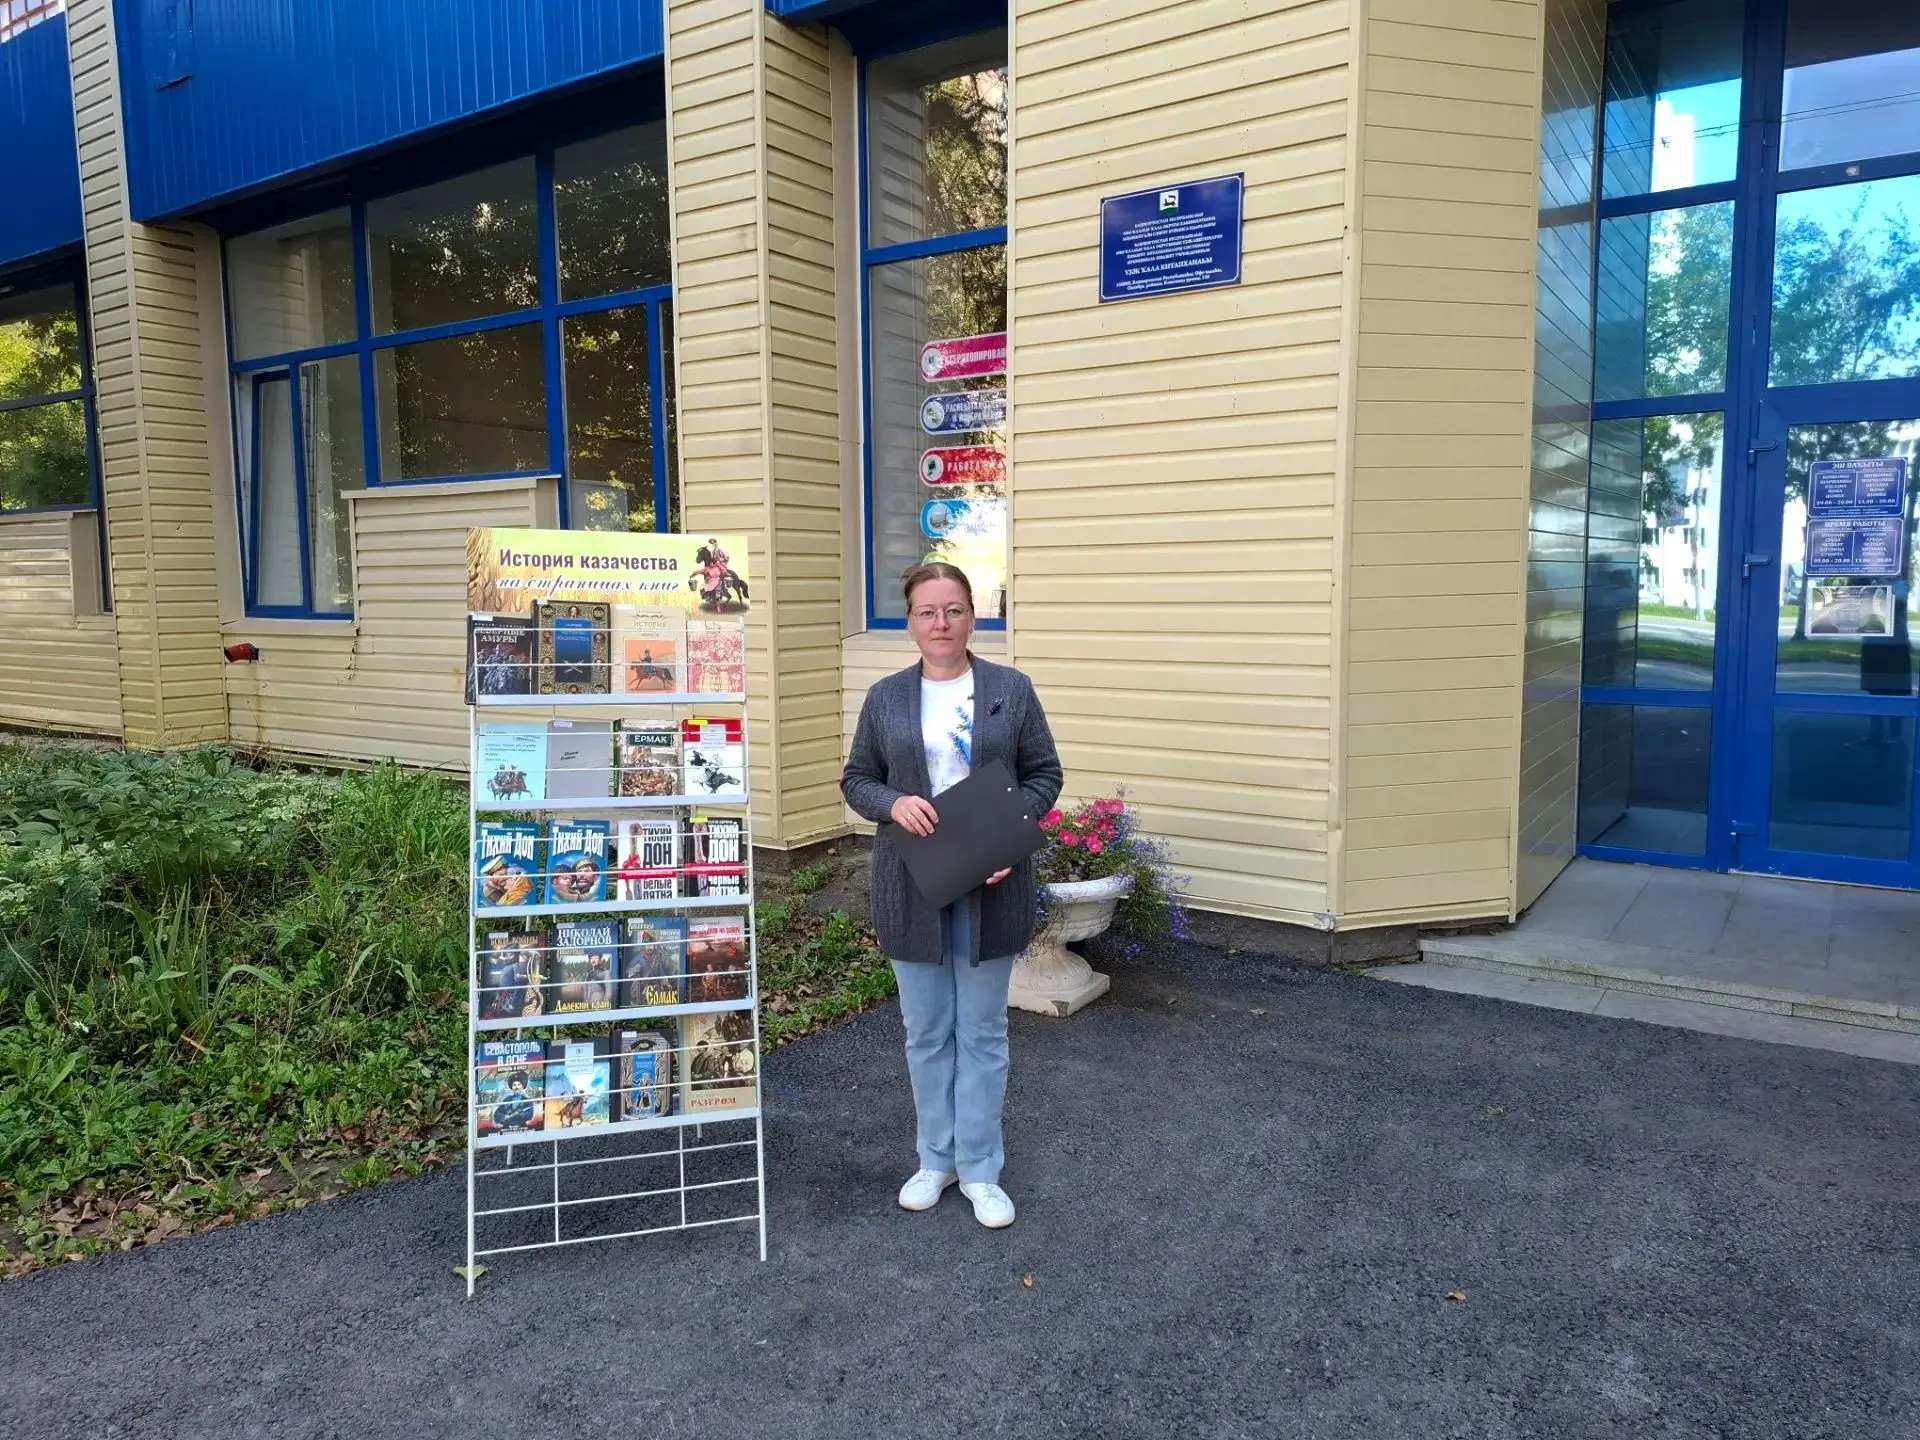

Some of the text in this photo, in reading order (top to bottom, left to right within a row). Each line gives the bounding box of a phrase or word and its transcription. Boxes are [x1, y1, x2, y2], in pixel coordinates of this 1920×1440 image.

[500, 549, 678, 571] История казачества
[499, 575, 680, 595] на страницах книг
[481, 634, 518, 644] АМУРЫ
[634, 735, 668, 744] ЕРМАК
[514, 832, 535, 861] Дон
[584, 829, 605, 858] Дон
[708, 839, 739, 864] ДОН
[643, 842, 672, 868] ДОН
[557, 926, 611, 940] НИКОЛАЙ
[557, 936, 612, 947] ЗАДОРНОВ
[485, 1041, 540, 1056] СЕВАСТОПОЛЬ
[691, 1096, 736, 1107] РАЗГРОМ
